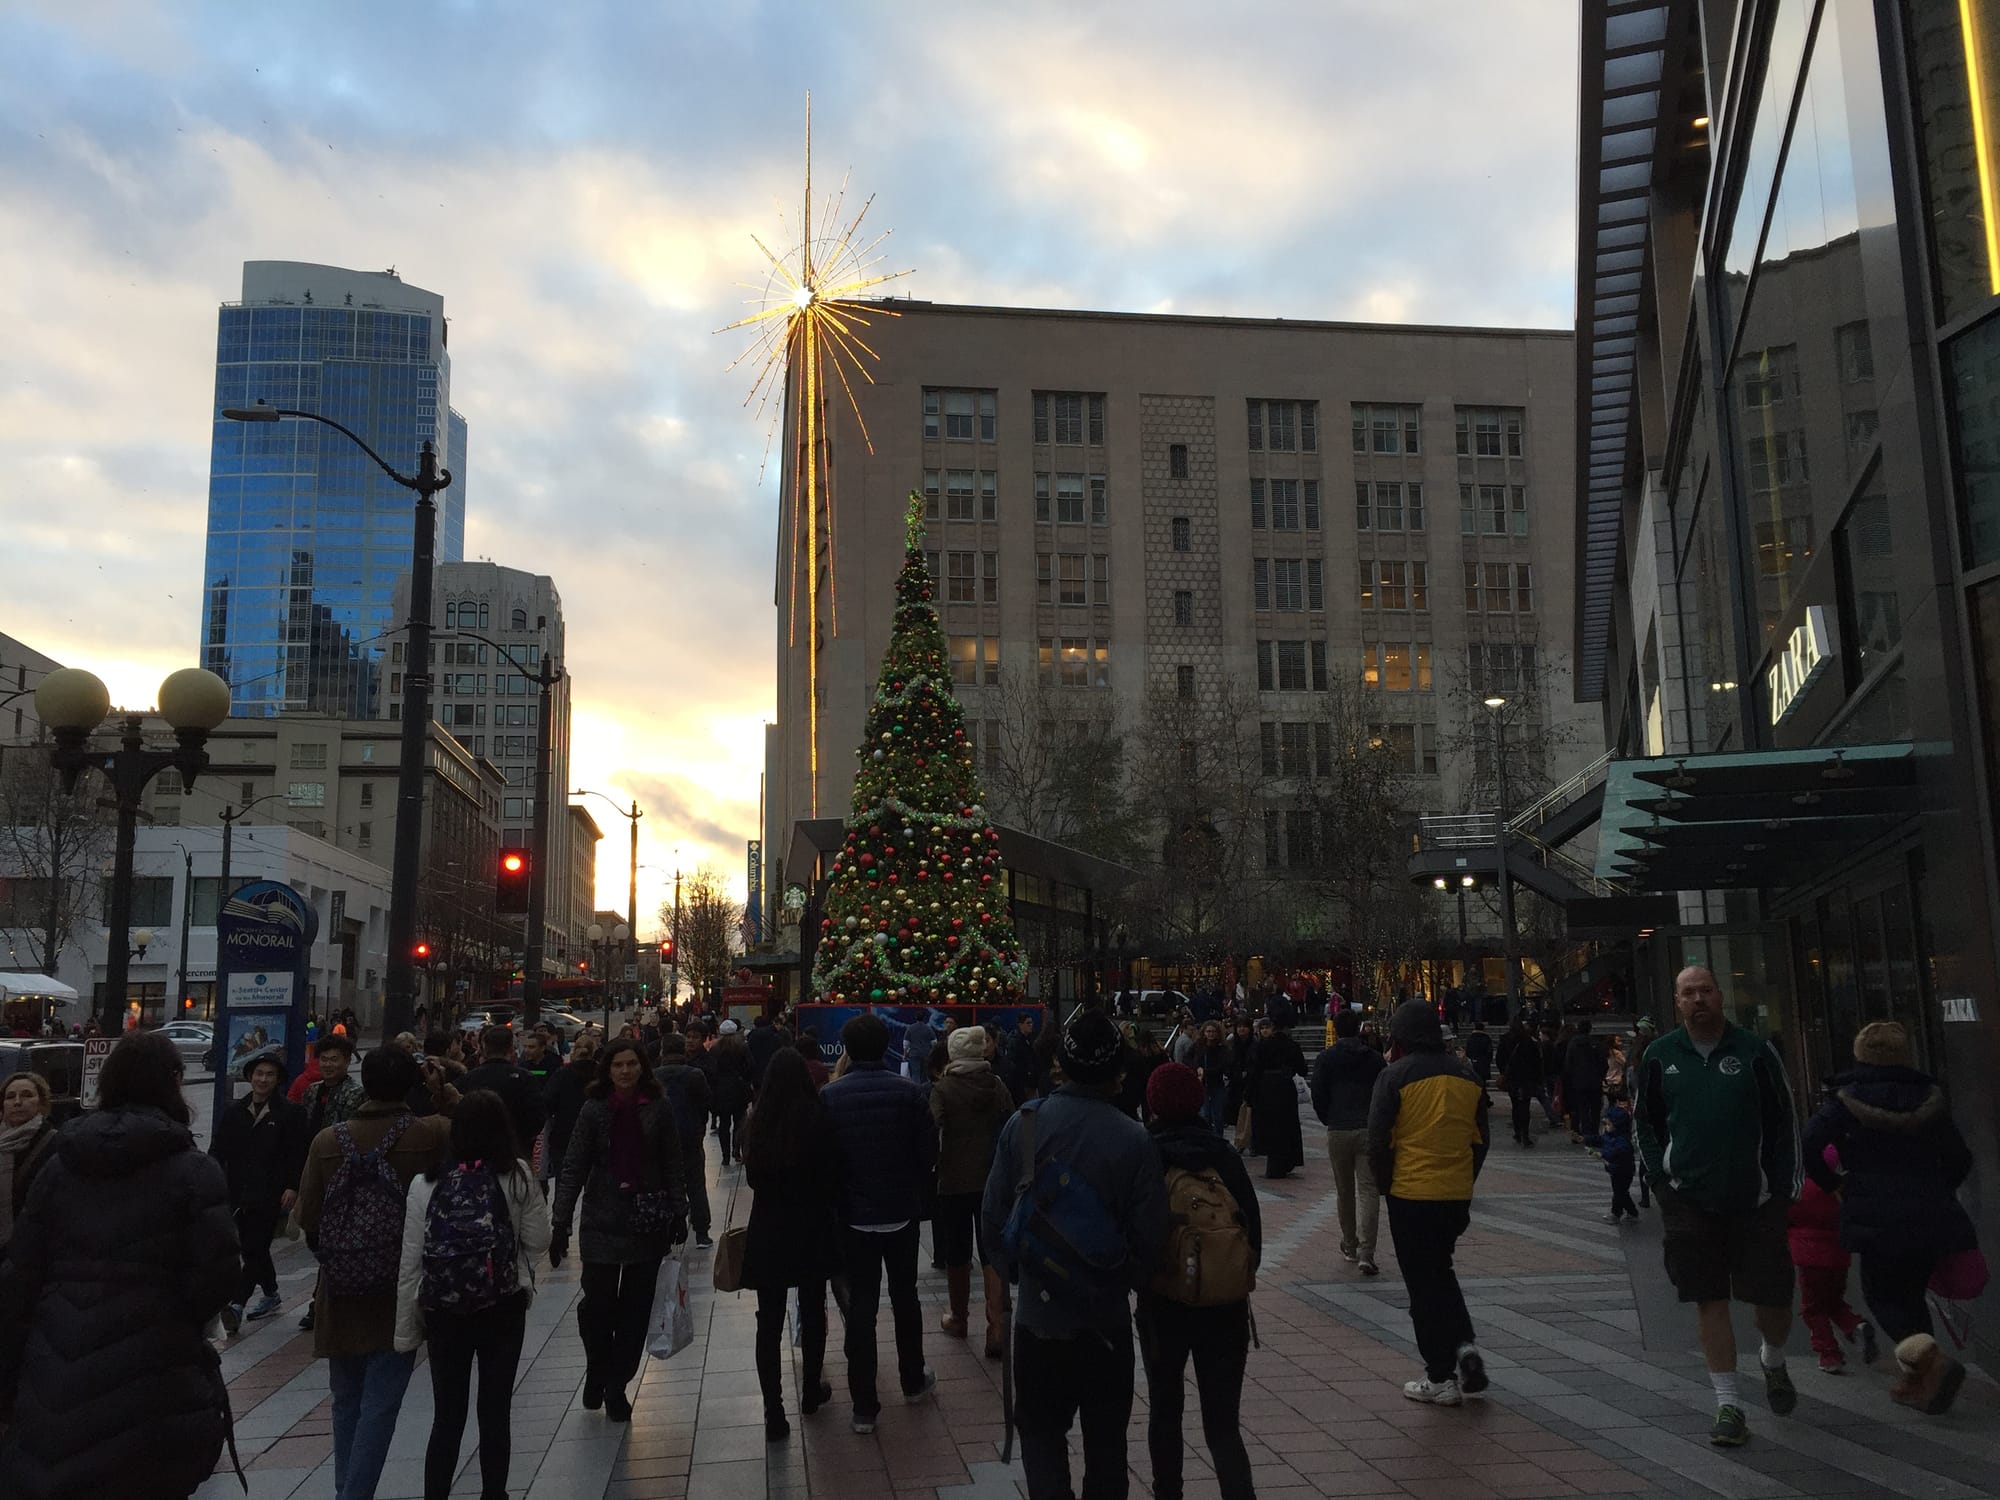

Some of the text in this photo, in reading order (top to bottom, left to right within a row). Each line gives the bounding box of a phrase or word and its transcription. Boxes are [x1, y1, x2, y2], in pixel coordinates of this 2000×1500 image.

[1769, 606, 1821, 726] ZARA
[749, 851, 759, 892] Columbia
[226, 933, 295, 948] MONORAIL
[89, 1041, 107, 1053] NO
